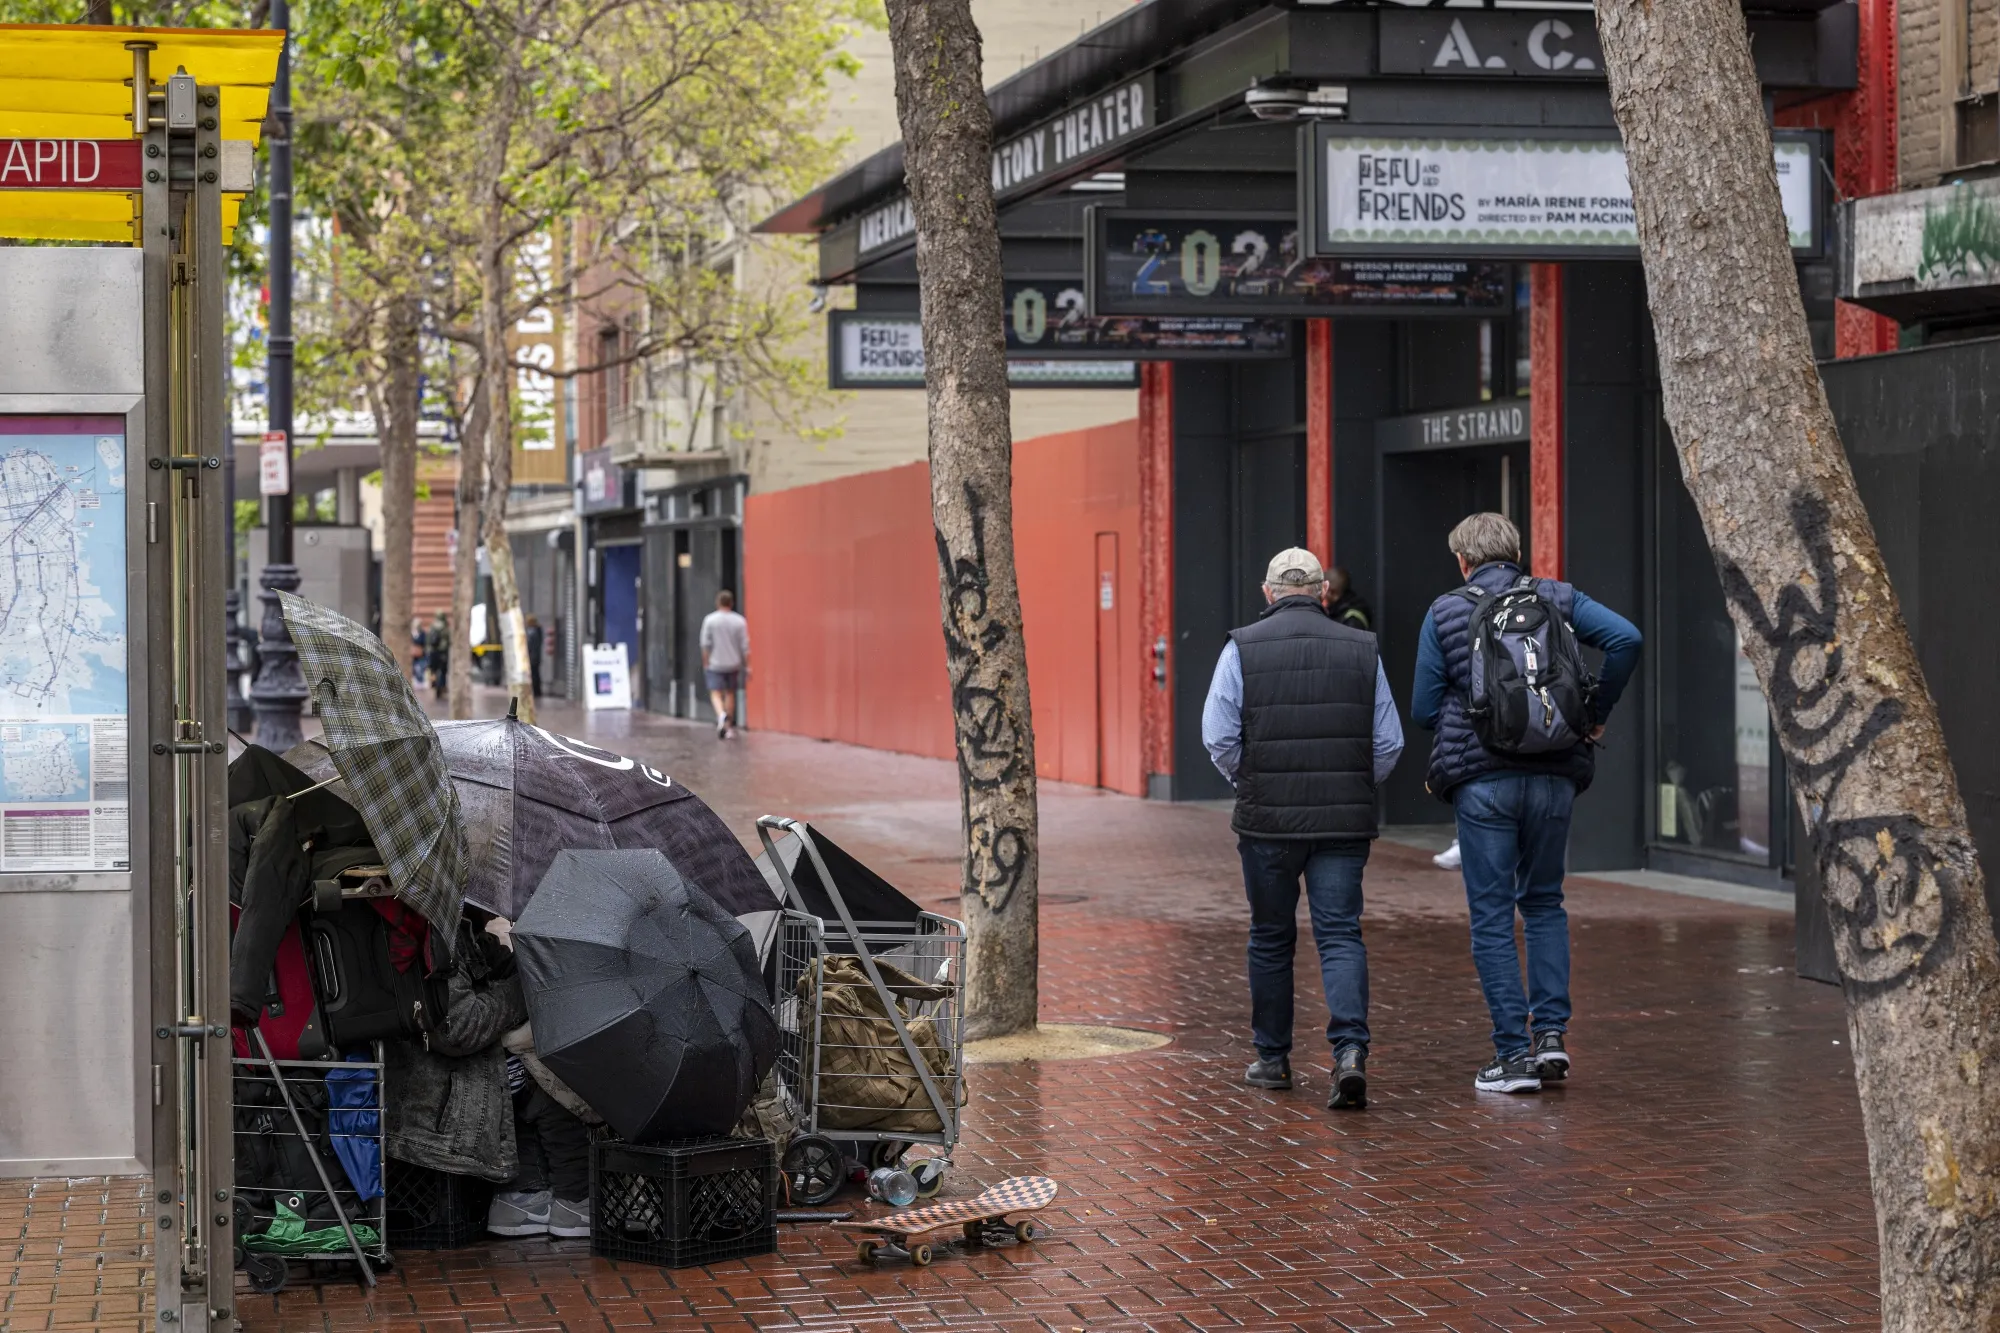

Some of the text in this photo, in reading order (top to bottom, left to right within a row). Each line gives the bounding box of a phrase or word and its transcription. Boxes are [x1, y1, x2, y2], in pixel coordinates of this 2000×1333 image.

[1433, 17, 1596, 71] A. C.
[1, 140, 101, 182] APID
[859, 83, 1145, 254] AMERICA ATORY THEATER
[1357, 154, 1420, 187] FEFU
[1357, 189, 1466, 221] FRIENDS
[1478, 199, 1491, 207] BY
[1495, 194, 1541, 208] MARÍA
[1545, 197, 1586, 208] IRENE
[1478, 211, 1635, 224] DIRECTED BY PAM MACKIN
[1386, 272, 1429, 281] JANUARY
[1422, 407, 1523, 444] THE STRAND
